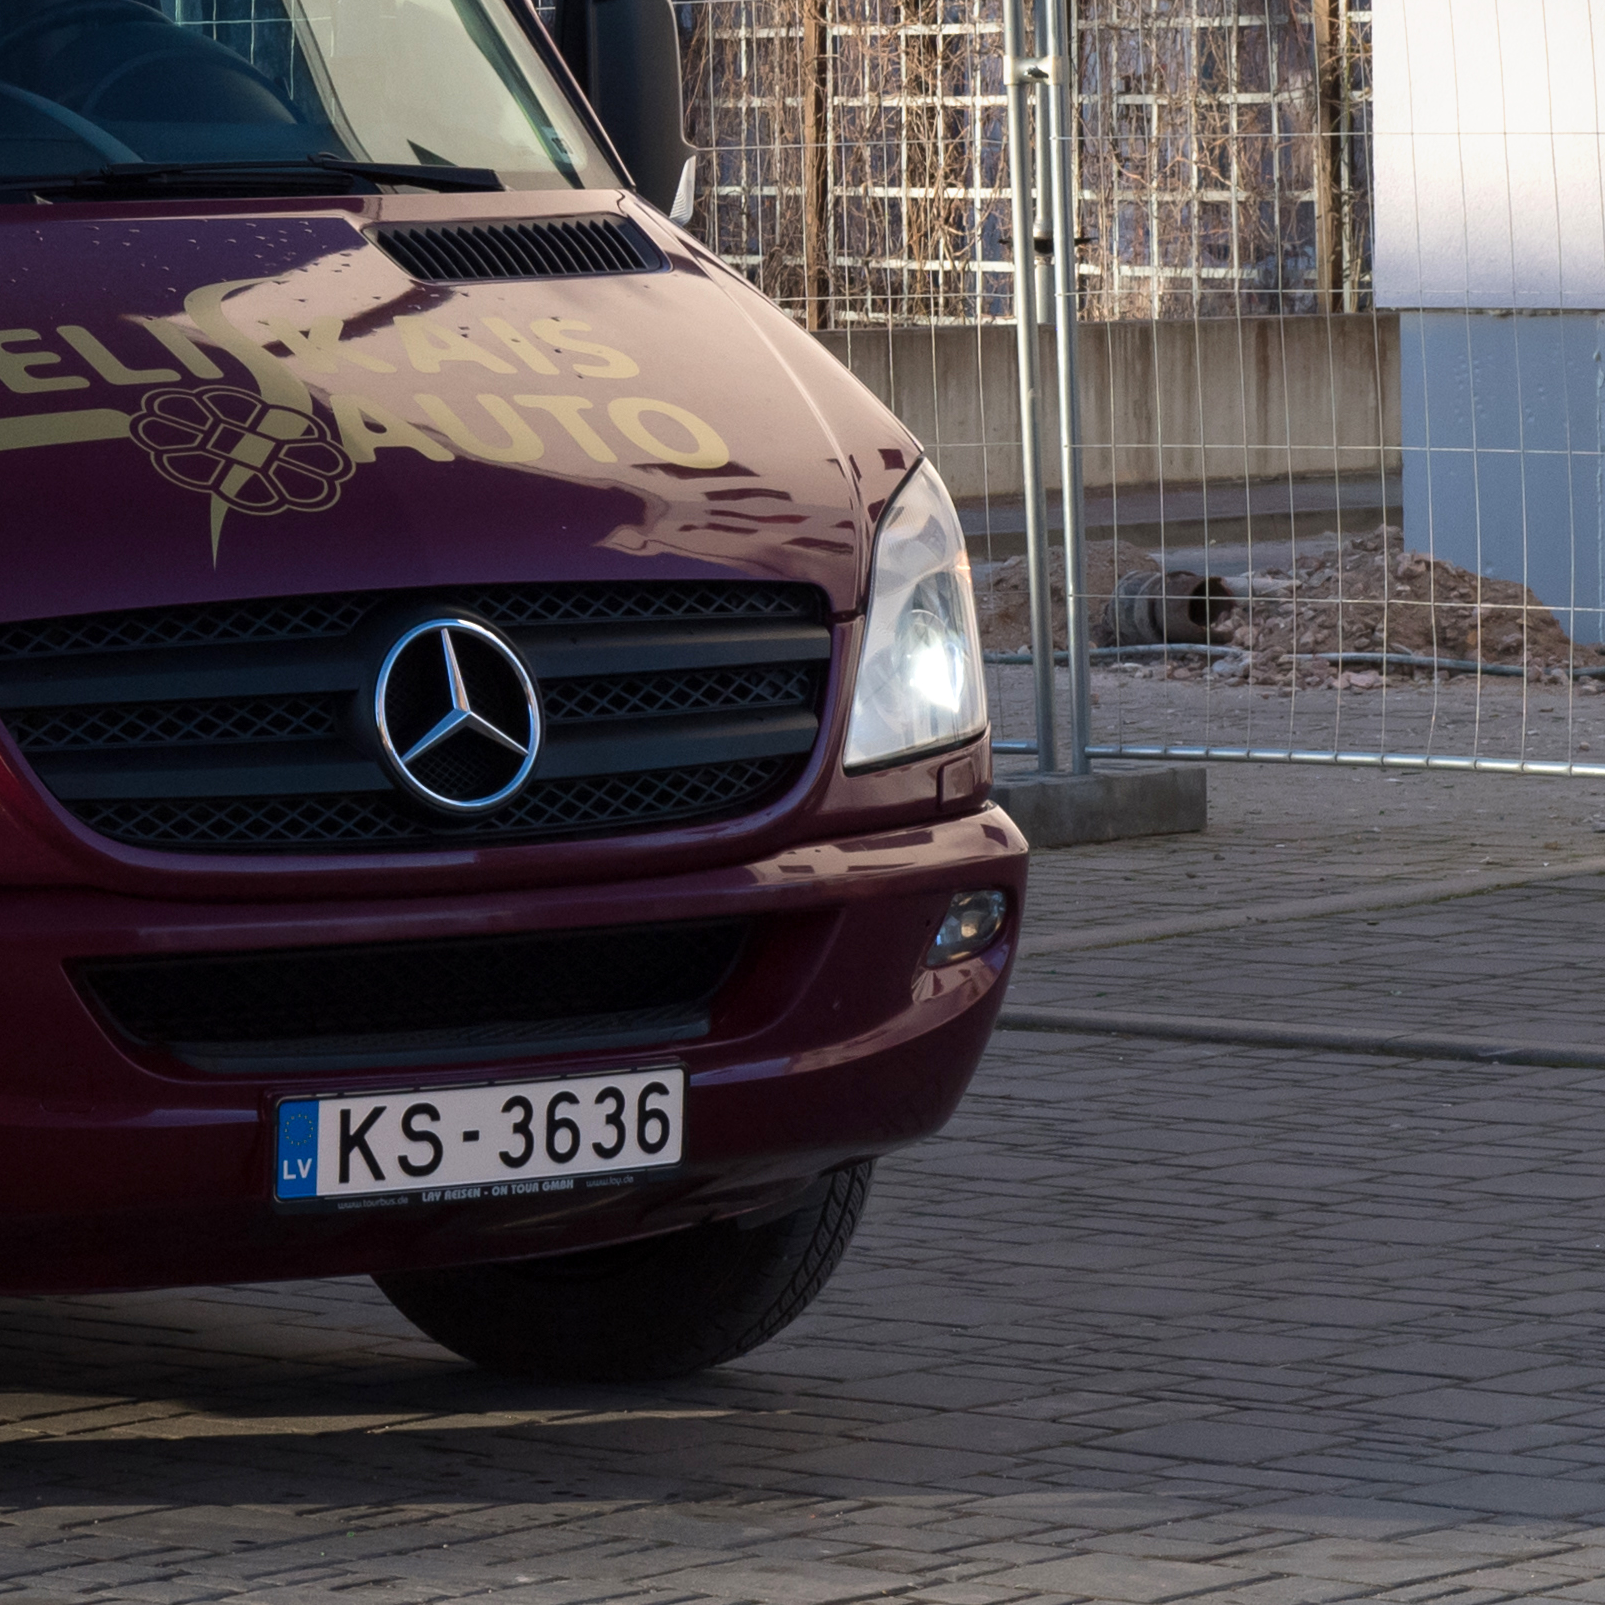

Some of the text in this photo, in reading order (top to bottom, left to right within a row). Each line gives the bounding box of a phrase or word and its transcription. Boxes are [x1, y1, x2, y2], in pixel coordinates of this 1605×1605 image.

[330, 393, 731, 470] AUTO
[282, 1158, 313, 1180] LV
[422, 1191, 442, 1203] LAY
[445, 1187, 481, 1201] REISEN
[492, 1184, 508, 1196] ON
[511, 1182, 540, 1195] TOUR
[542, 1179, 574, 1192] GMBH
[337, 1196, 409, 1210] www.tourbus.de
